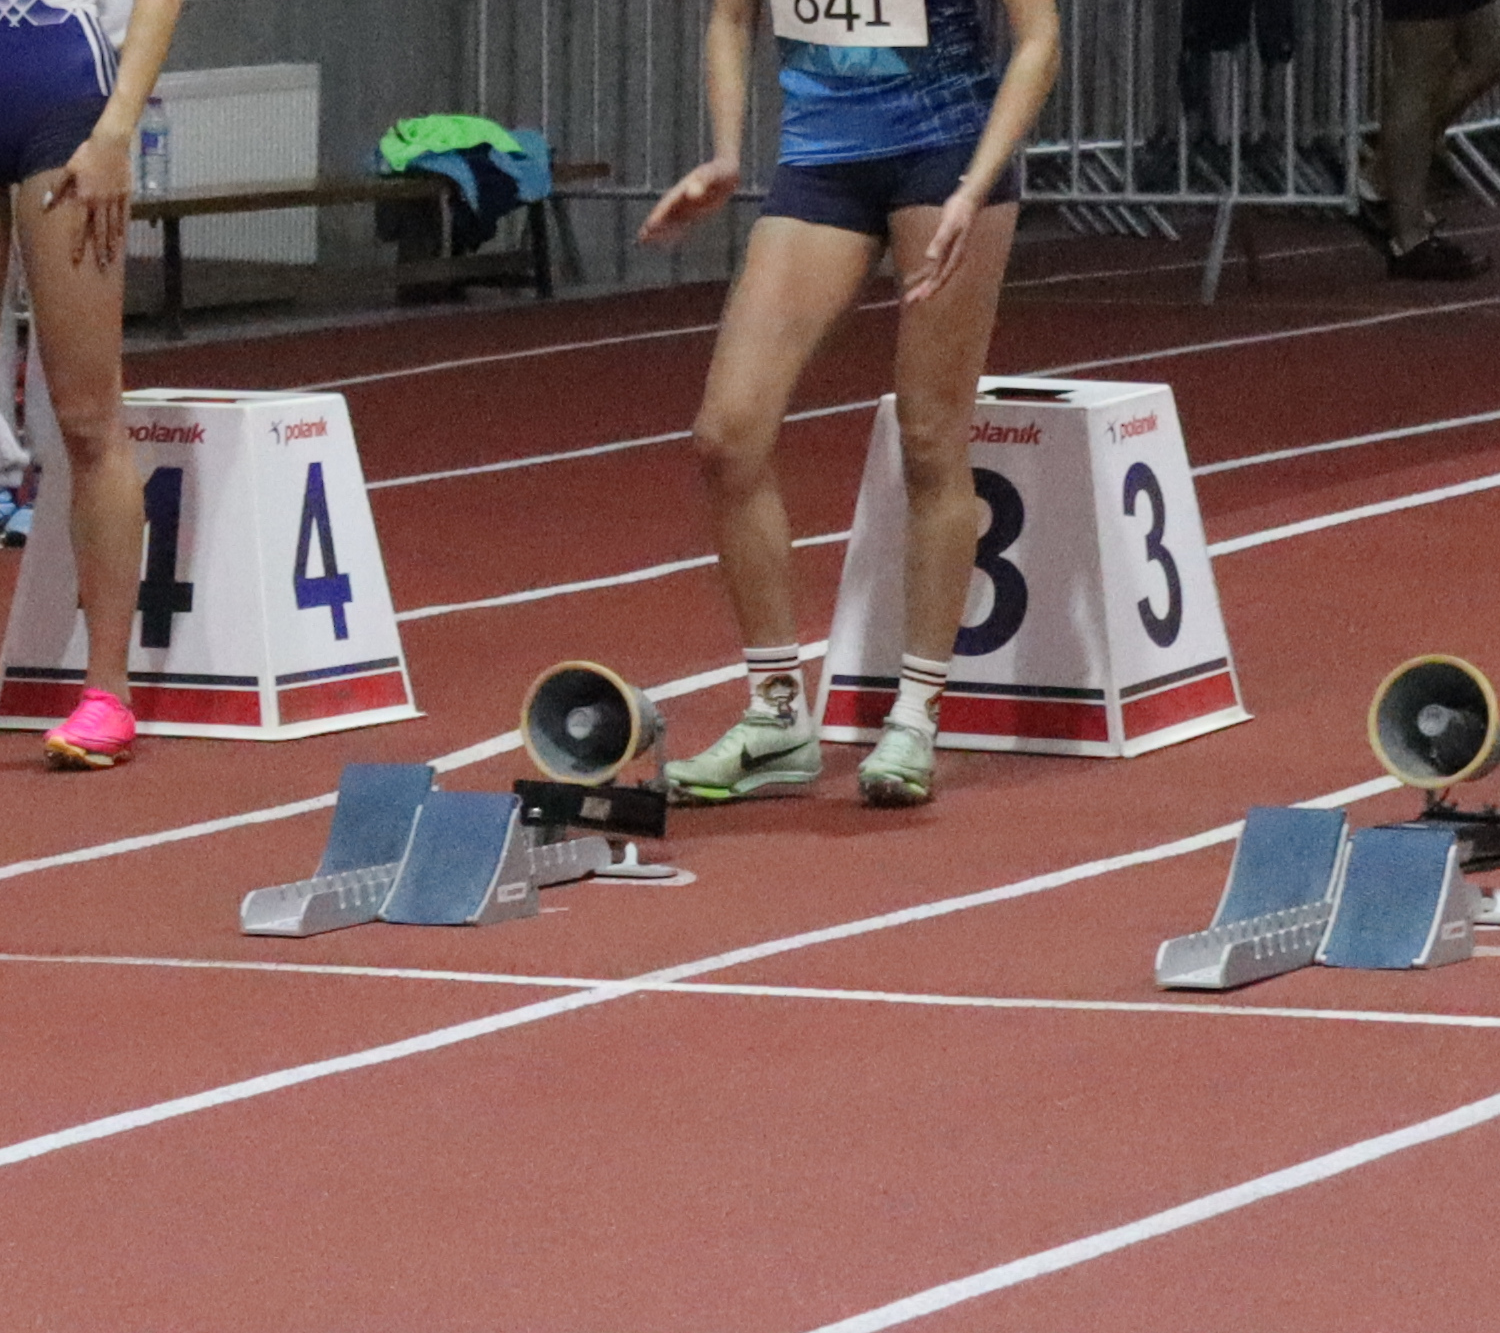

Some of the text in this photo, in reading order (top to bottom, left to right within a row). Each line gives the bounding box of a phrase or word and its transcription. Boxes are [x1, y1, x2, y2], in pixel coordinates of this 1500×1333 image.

[968, 420, 1043, 446] olanik
[293, 462, 354, 641] 4
[1122, 462, 1184, 648] 3
